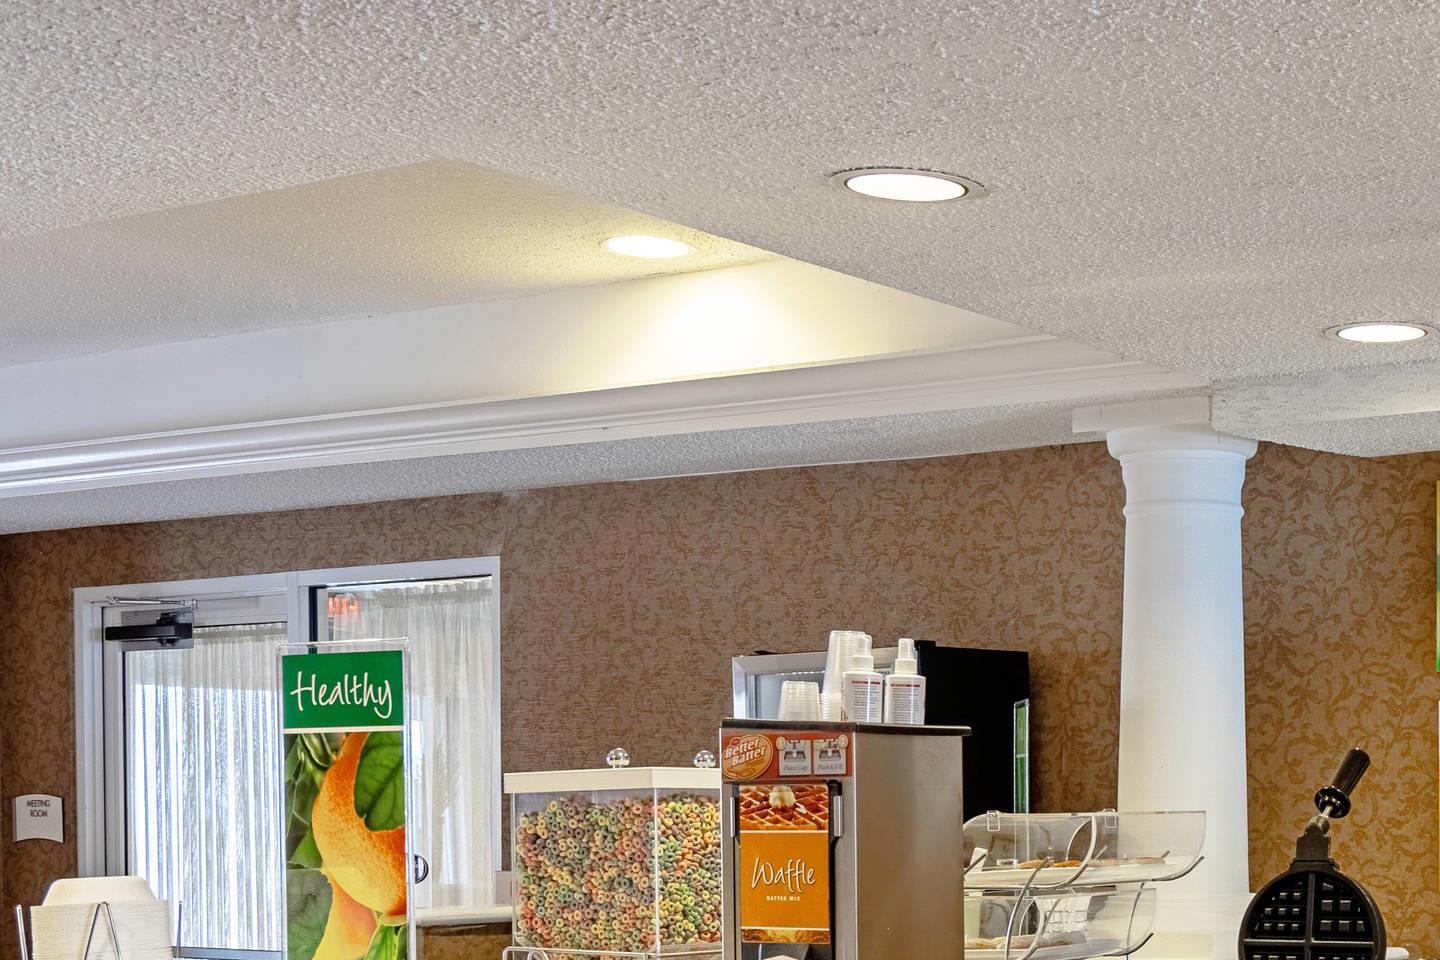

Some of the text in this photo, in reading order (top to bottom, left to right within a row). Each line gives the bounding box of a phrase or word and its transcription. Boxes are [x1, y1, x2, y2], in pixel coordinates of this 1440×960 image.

[290, 671, 393, 719] Healthy
[725, 738, 760, 759] Better
[732, 745, 768, 767] Batter
[26, 799, 52, 808] MEETING
[30, 809, 49, 818] ROOM
[751, 856, 816, 893] Waffle
